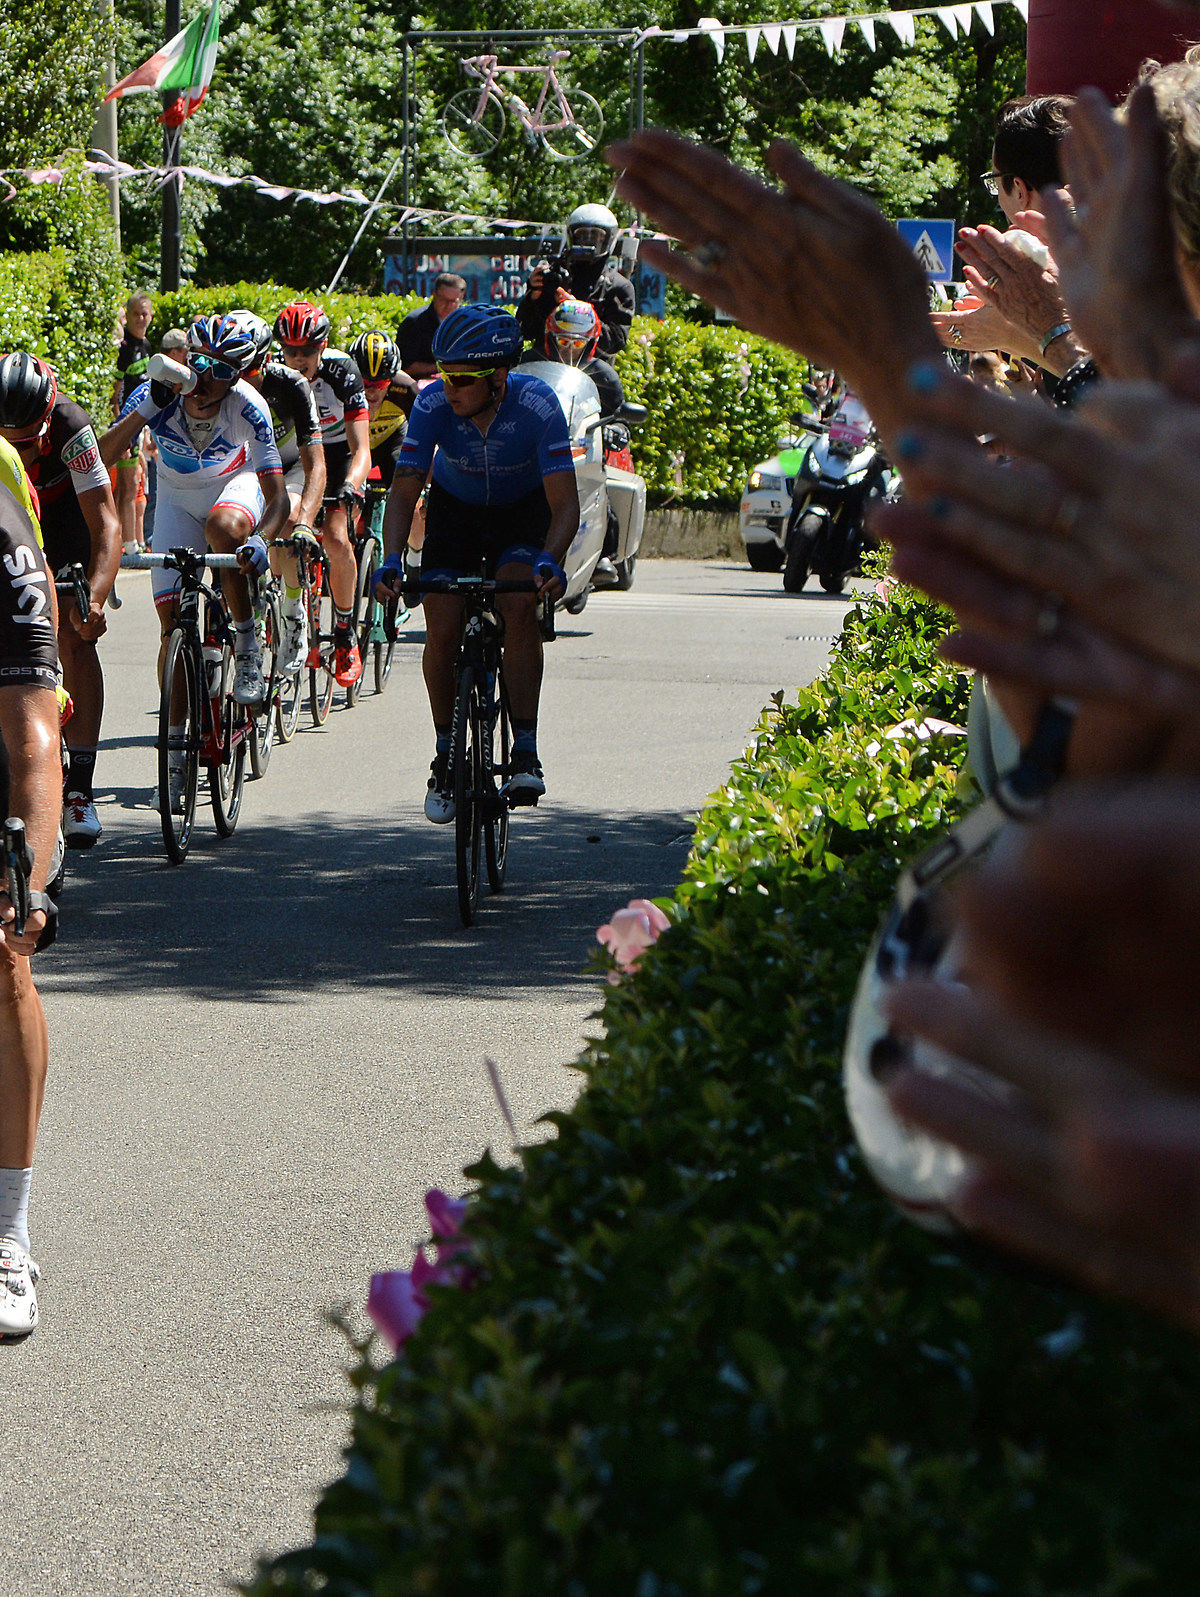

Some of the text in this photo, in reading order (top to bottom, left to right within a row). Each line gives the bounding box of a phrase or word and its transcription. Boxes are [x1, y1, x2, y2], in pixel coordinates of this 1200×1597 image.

[63, 432, 94, 460] TAG
[67, 446, 98, 474] HEUER
[3, 545, 51, 627] SKY
